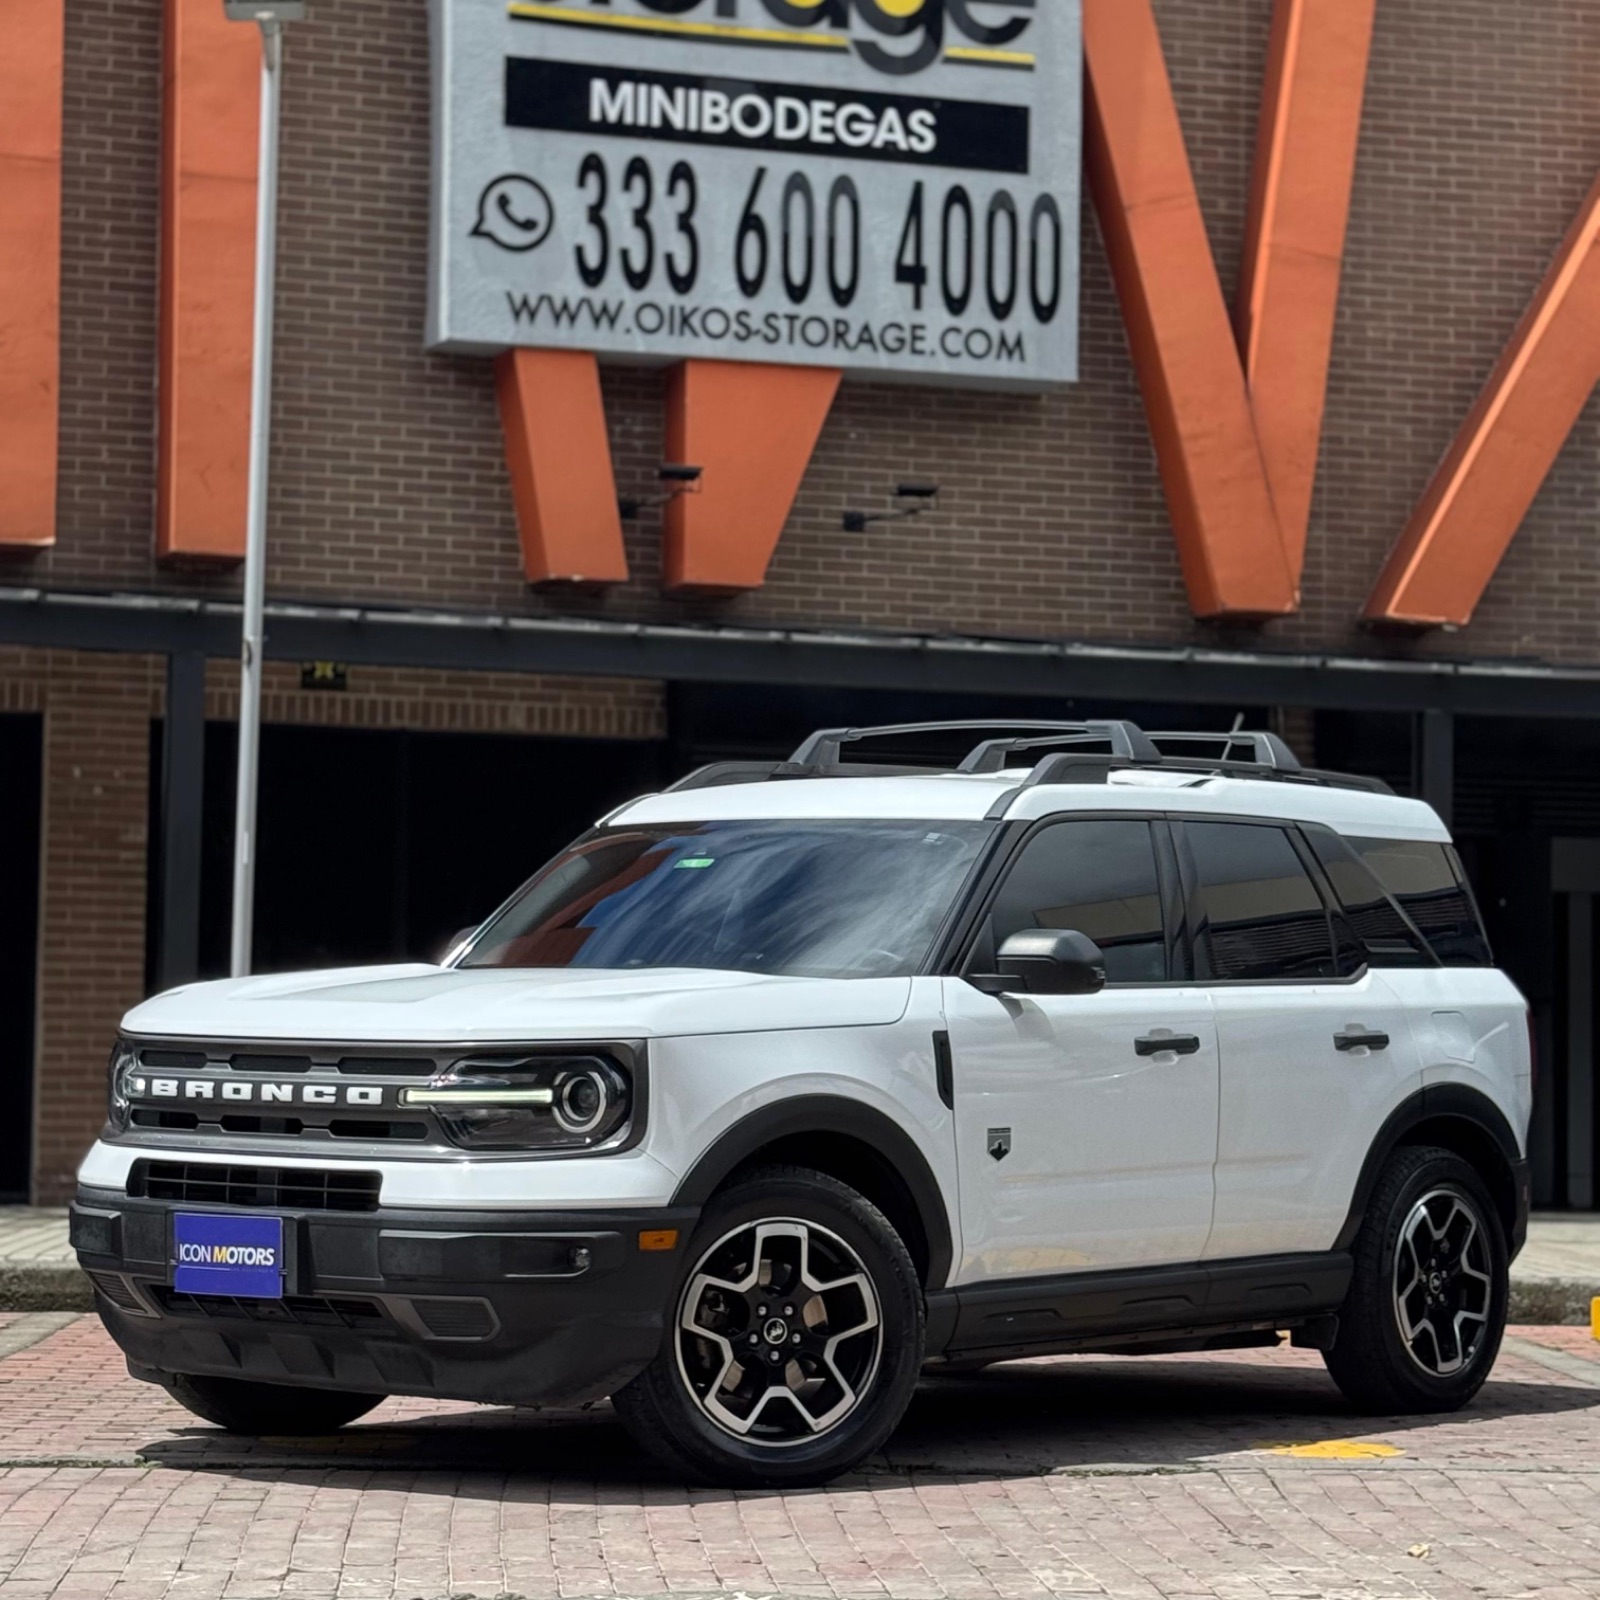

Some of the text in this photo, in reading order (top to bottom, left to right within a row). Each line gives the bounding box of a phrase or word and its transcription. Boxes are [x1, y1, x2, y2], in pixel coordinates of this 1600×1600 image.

[589, 78, 937, 153] MINIBODEGAS
[574, 152, 1062, 325] 333 600 4000
[505, 289, 1026, 364] WWW.OIKOS-STORAGE.COM
[151, 1078, 384, 1106] BRONCO
[179, 1243, 275, 1267] ICON MOTORS
